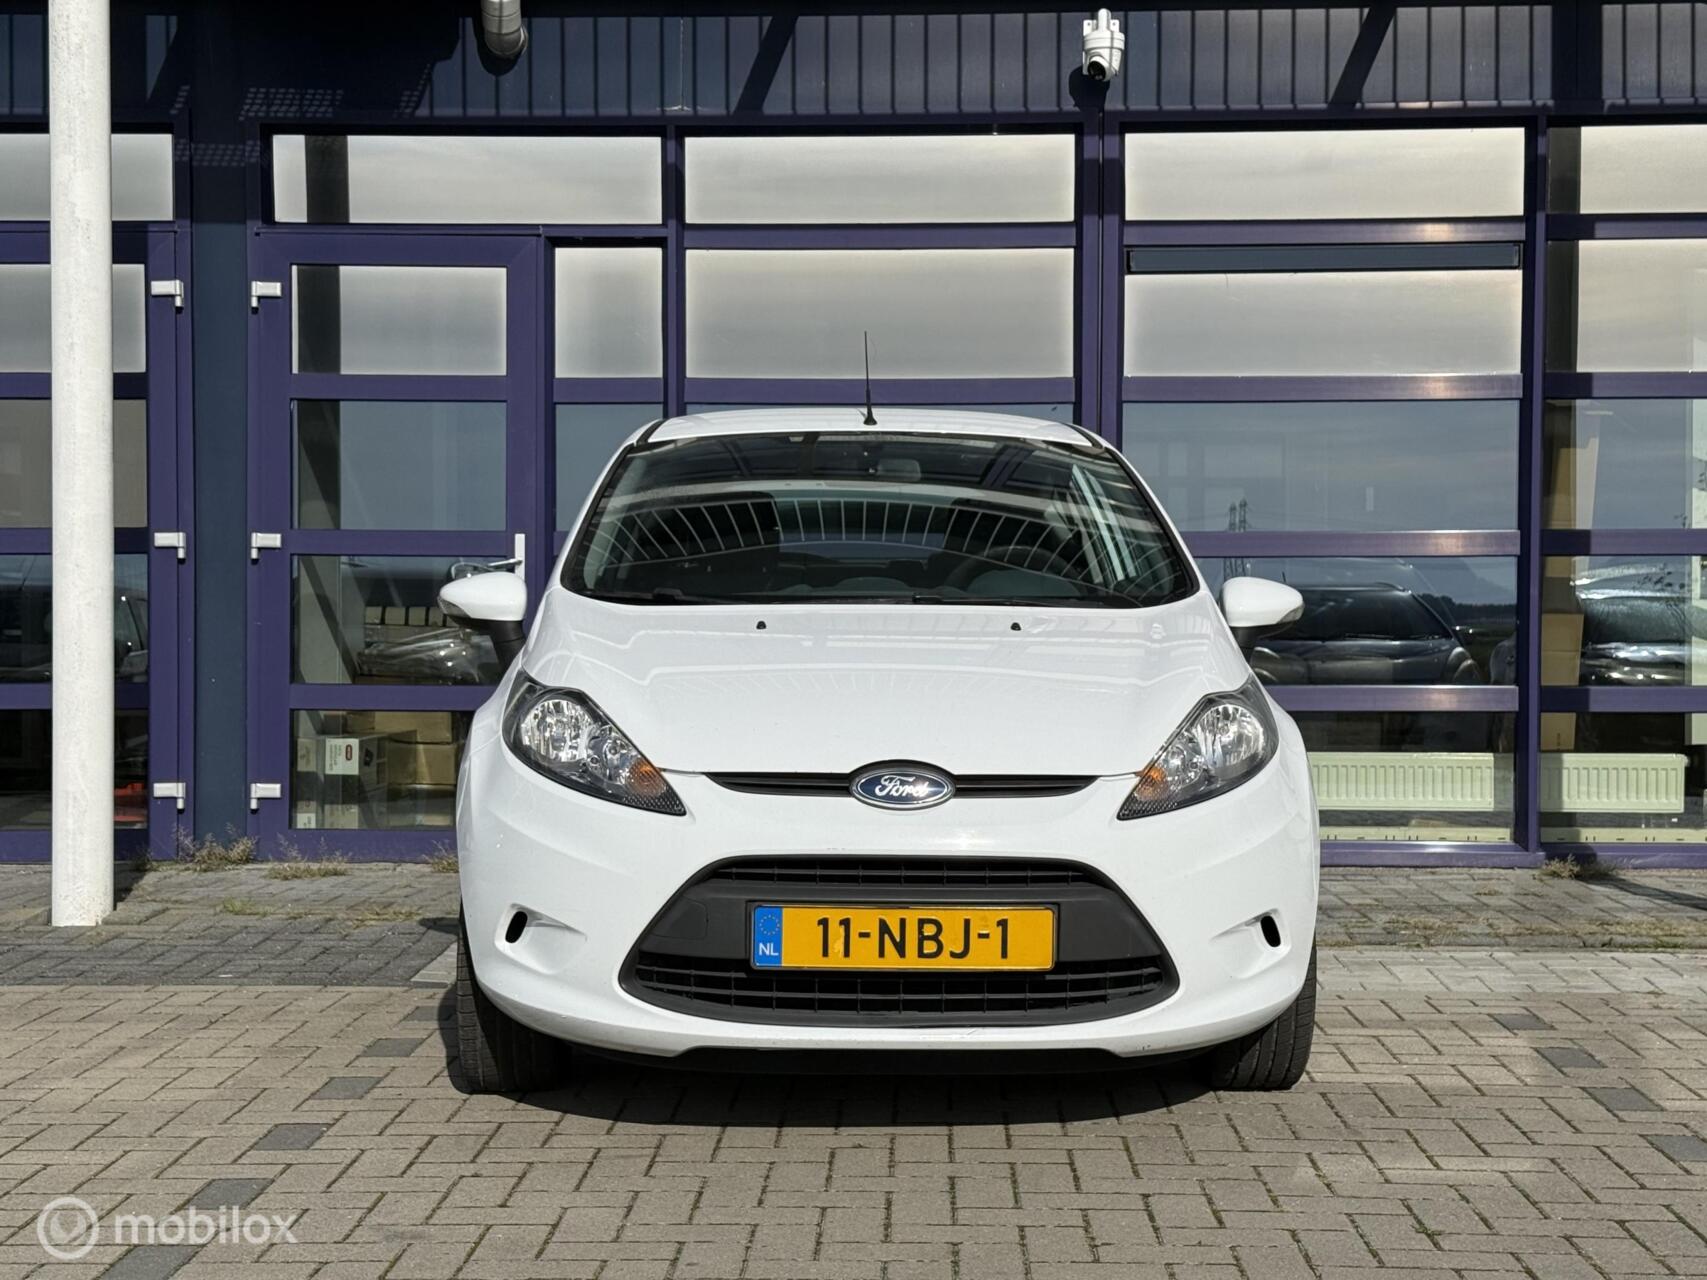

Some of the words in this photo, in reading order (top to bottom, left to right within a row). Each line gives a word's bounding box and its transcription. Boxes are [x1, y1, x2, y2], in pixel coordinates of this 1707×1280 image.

[875, 775, 930, 797] Ford
[758, 942, 779, 956] NL
[817, 917, 1009, 959] 11-NBJ-1
